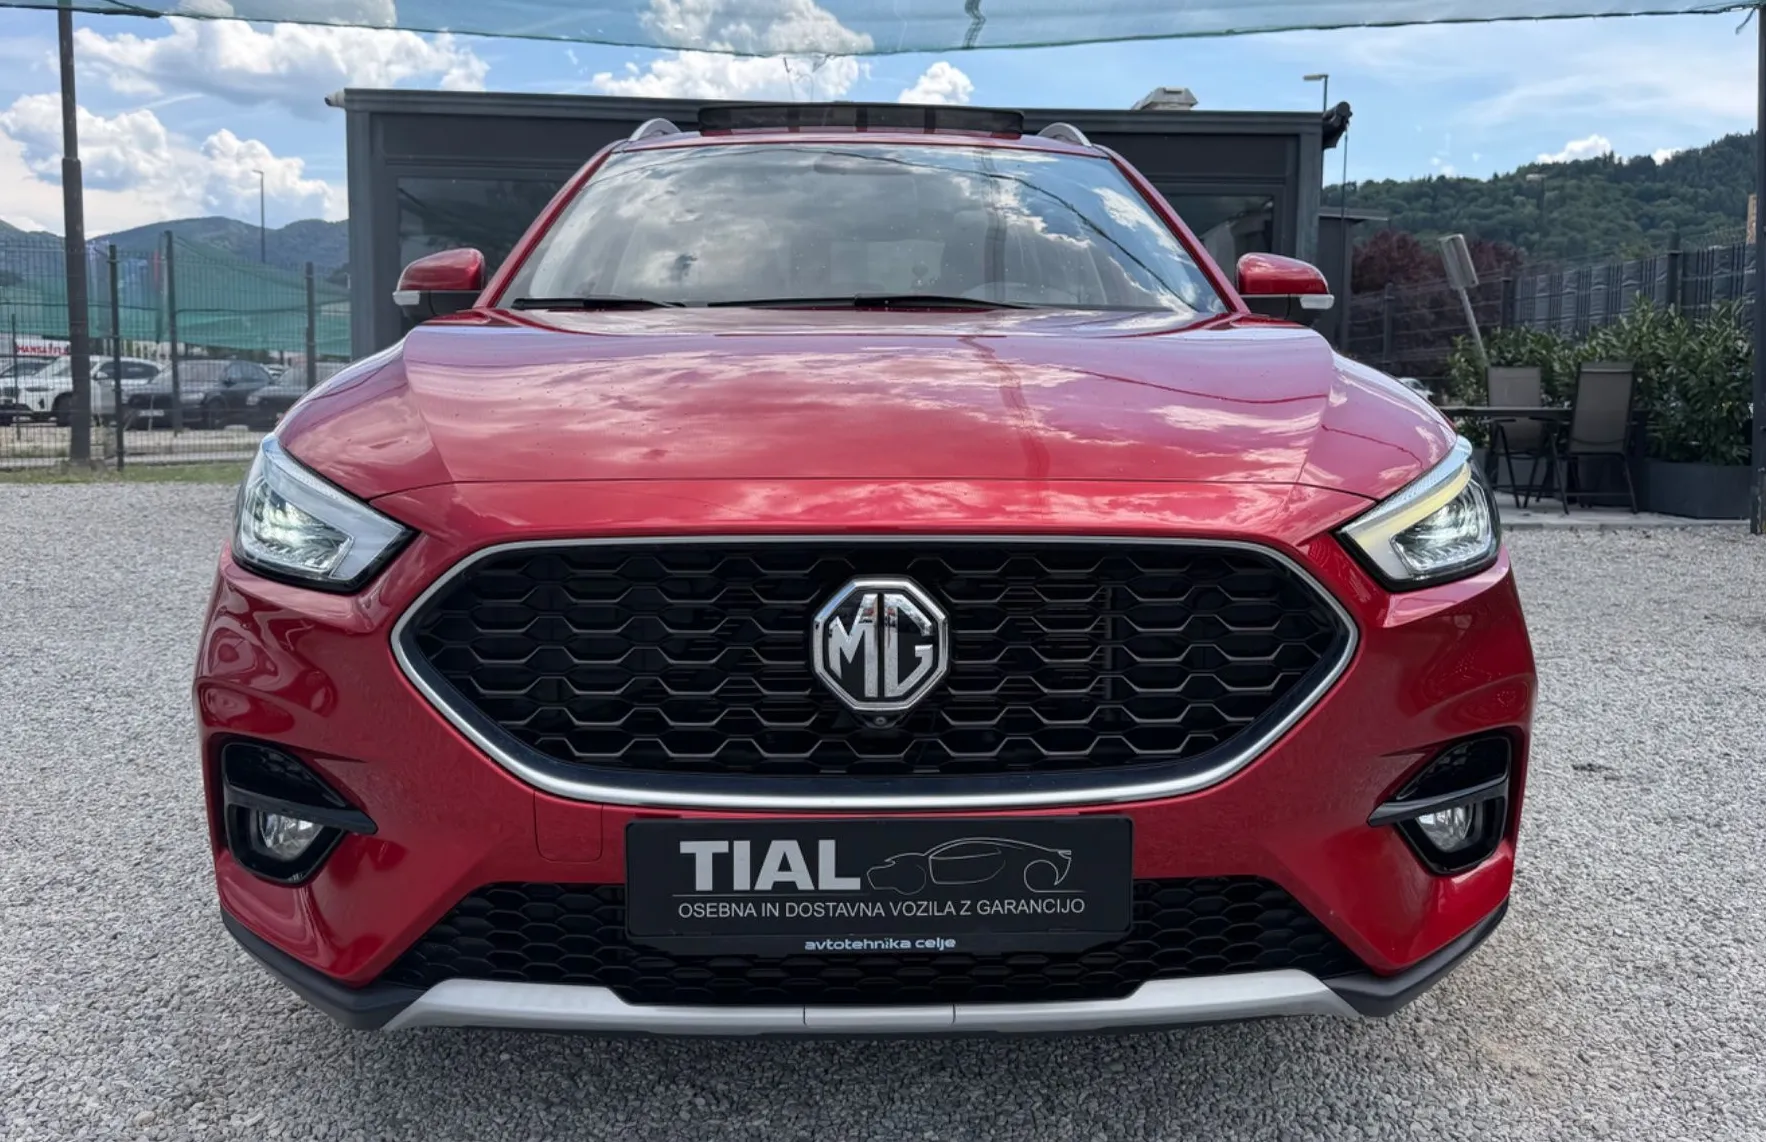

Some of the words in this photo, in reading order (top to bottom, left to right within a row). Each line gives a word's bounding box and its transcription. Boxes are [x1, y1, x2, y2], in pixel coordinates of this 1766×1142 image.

[828, 593, 934, 698] MG
[679, 839, 861, 892] TIAL
[678, 902, 757, 919] OSEBNA
[761, 902, 780, 918] IN
[785, 901, 885, 918] DOSTAVNA
[890, 900, 956, 917] VOZILA
[959, 900, 972, 916] Z
[976, 898, 1086, 915] GARANCIJO
[804, 938, 912, 951] avtotehnika
[915, 937, 957, 951] celje
